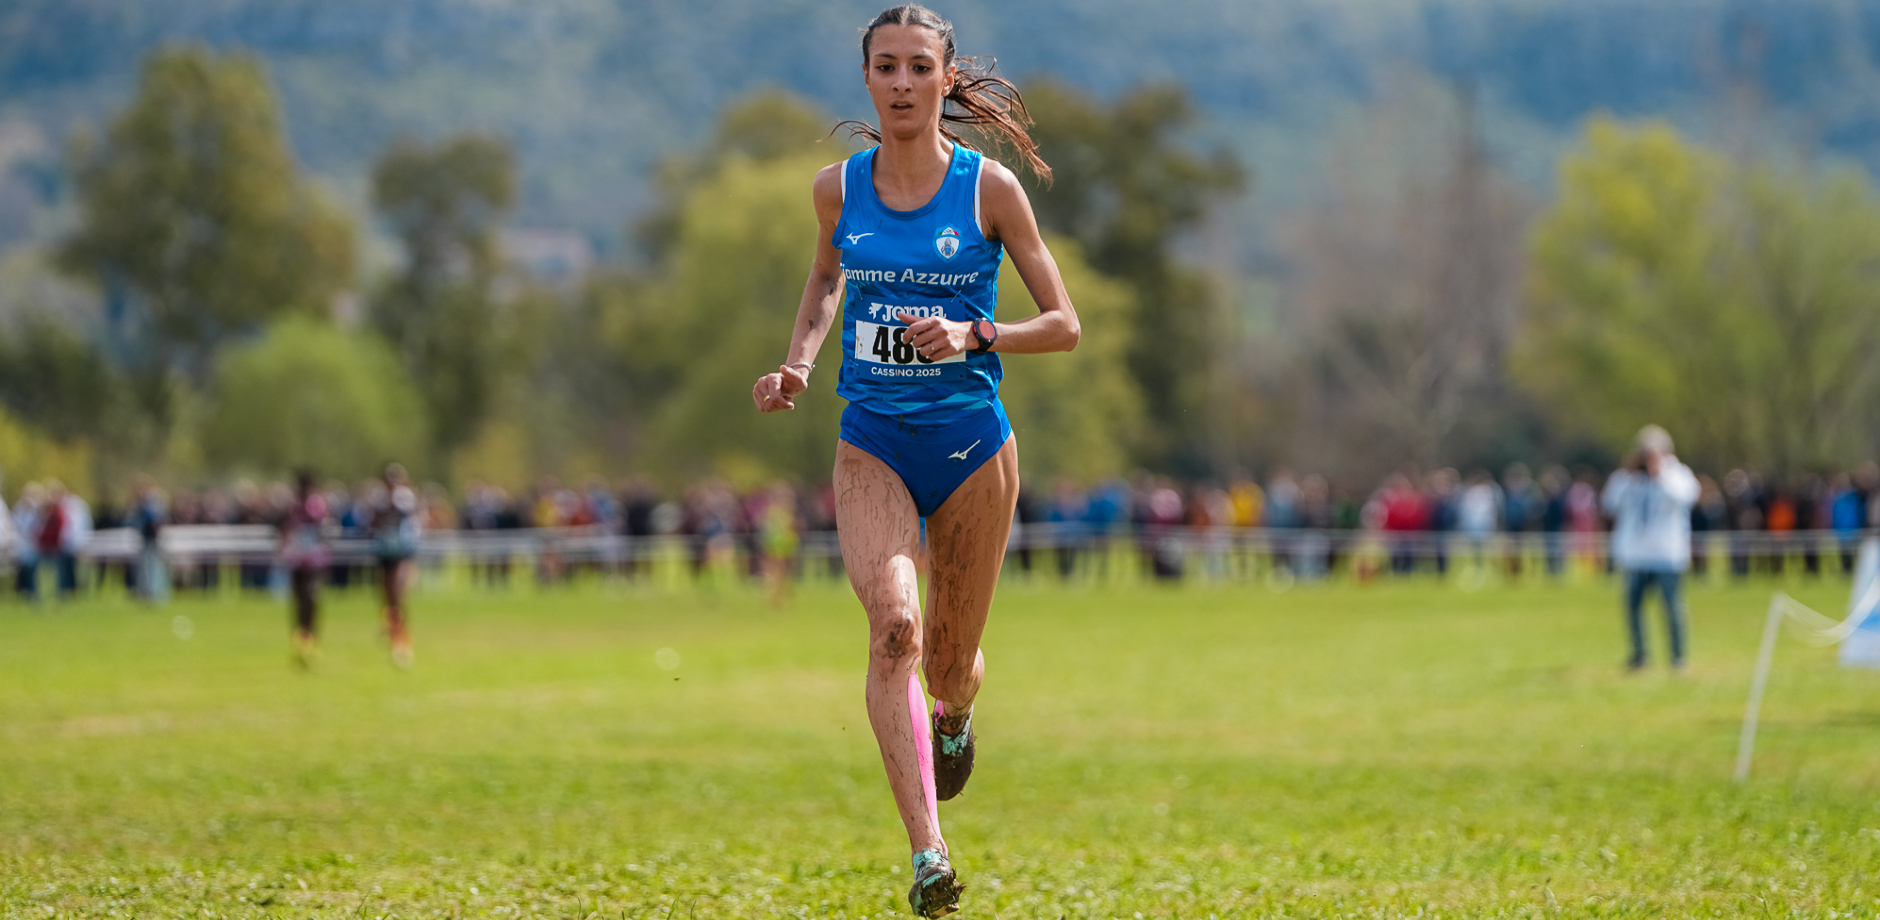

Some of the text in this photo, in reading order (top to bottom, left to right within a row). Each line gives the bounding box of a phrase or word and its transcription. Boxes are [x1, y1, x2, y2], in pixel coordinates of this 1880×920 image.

[840, 262, 979, 286] iamme Azzurre
[871, 366, 941, 377] CASSINO 2025
